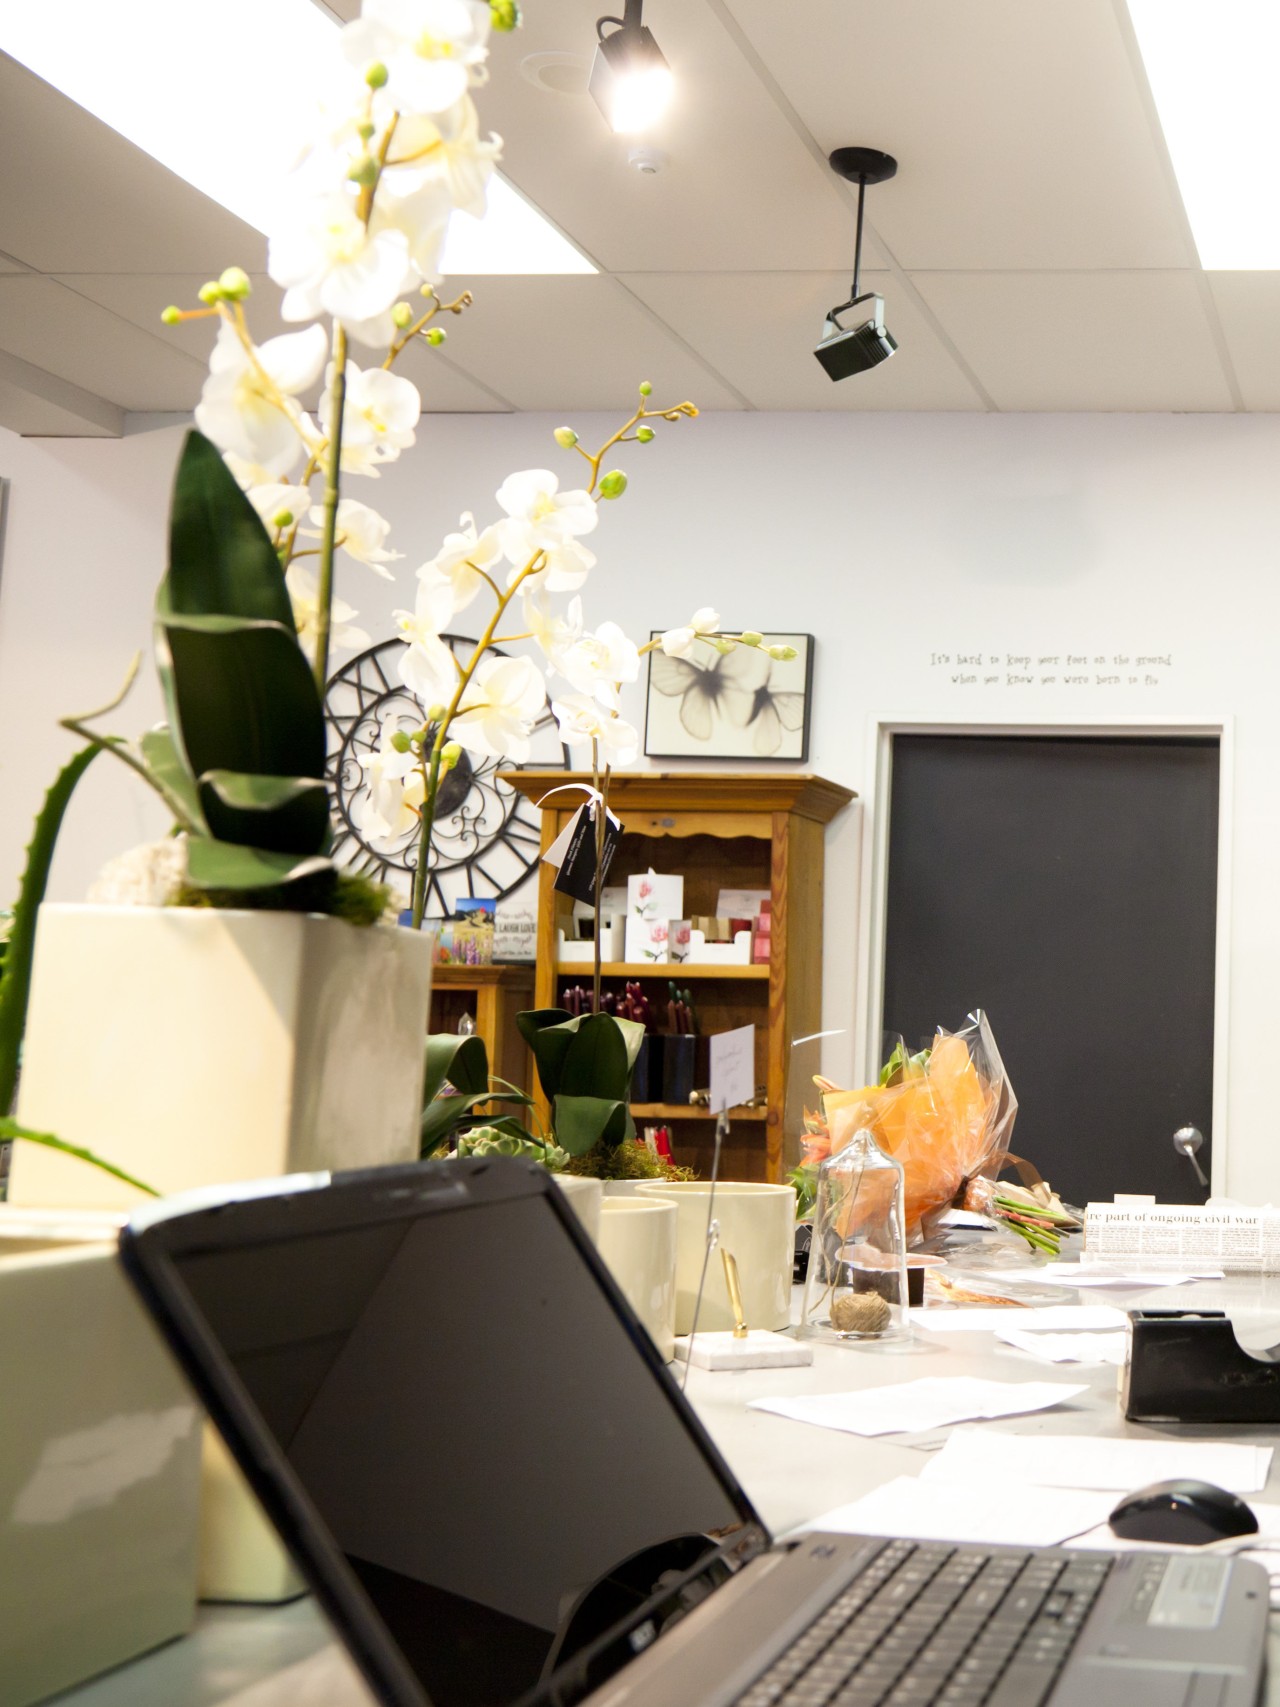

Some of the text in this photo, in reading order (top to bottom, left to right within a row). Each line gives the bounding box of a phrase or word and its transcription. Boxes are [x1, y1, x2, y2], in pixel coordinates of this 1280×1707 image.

[956, 653, 982, 665] hard
[990, 656, 999, 664] to
[1006, 653, 1031, 670] keep
[1038, 656, 1060, 665] your
[1094, 656, 1106, 664] on
[1113, 653, 1130, 665] the
[1136, 654, 1172, 667] ground
[951, 672, 1159, 686] when you know you were born to fly
[1106, 1212, 1130, 1223] part
[1134, 1211, 1147, 1222] of
[1151, 1213, 1201, 1224] ongoing
[1205, 1214, 1230, 1224] civil
[1236, 1216, 1259, 1225] war
